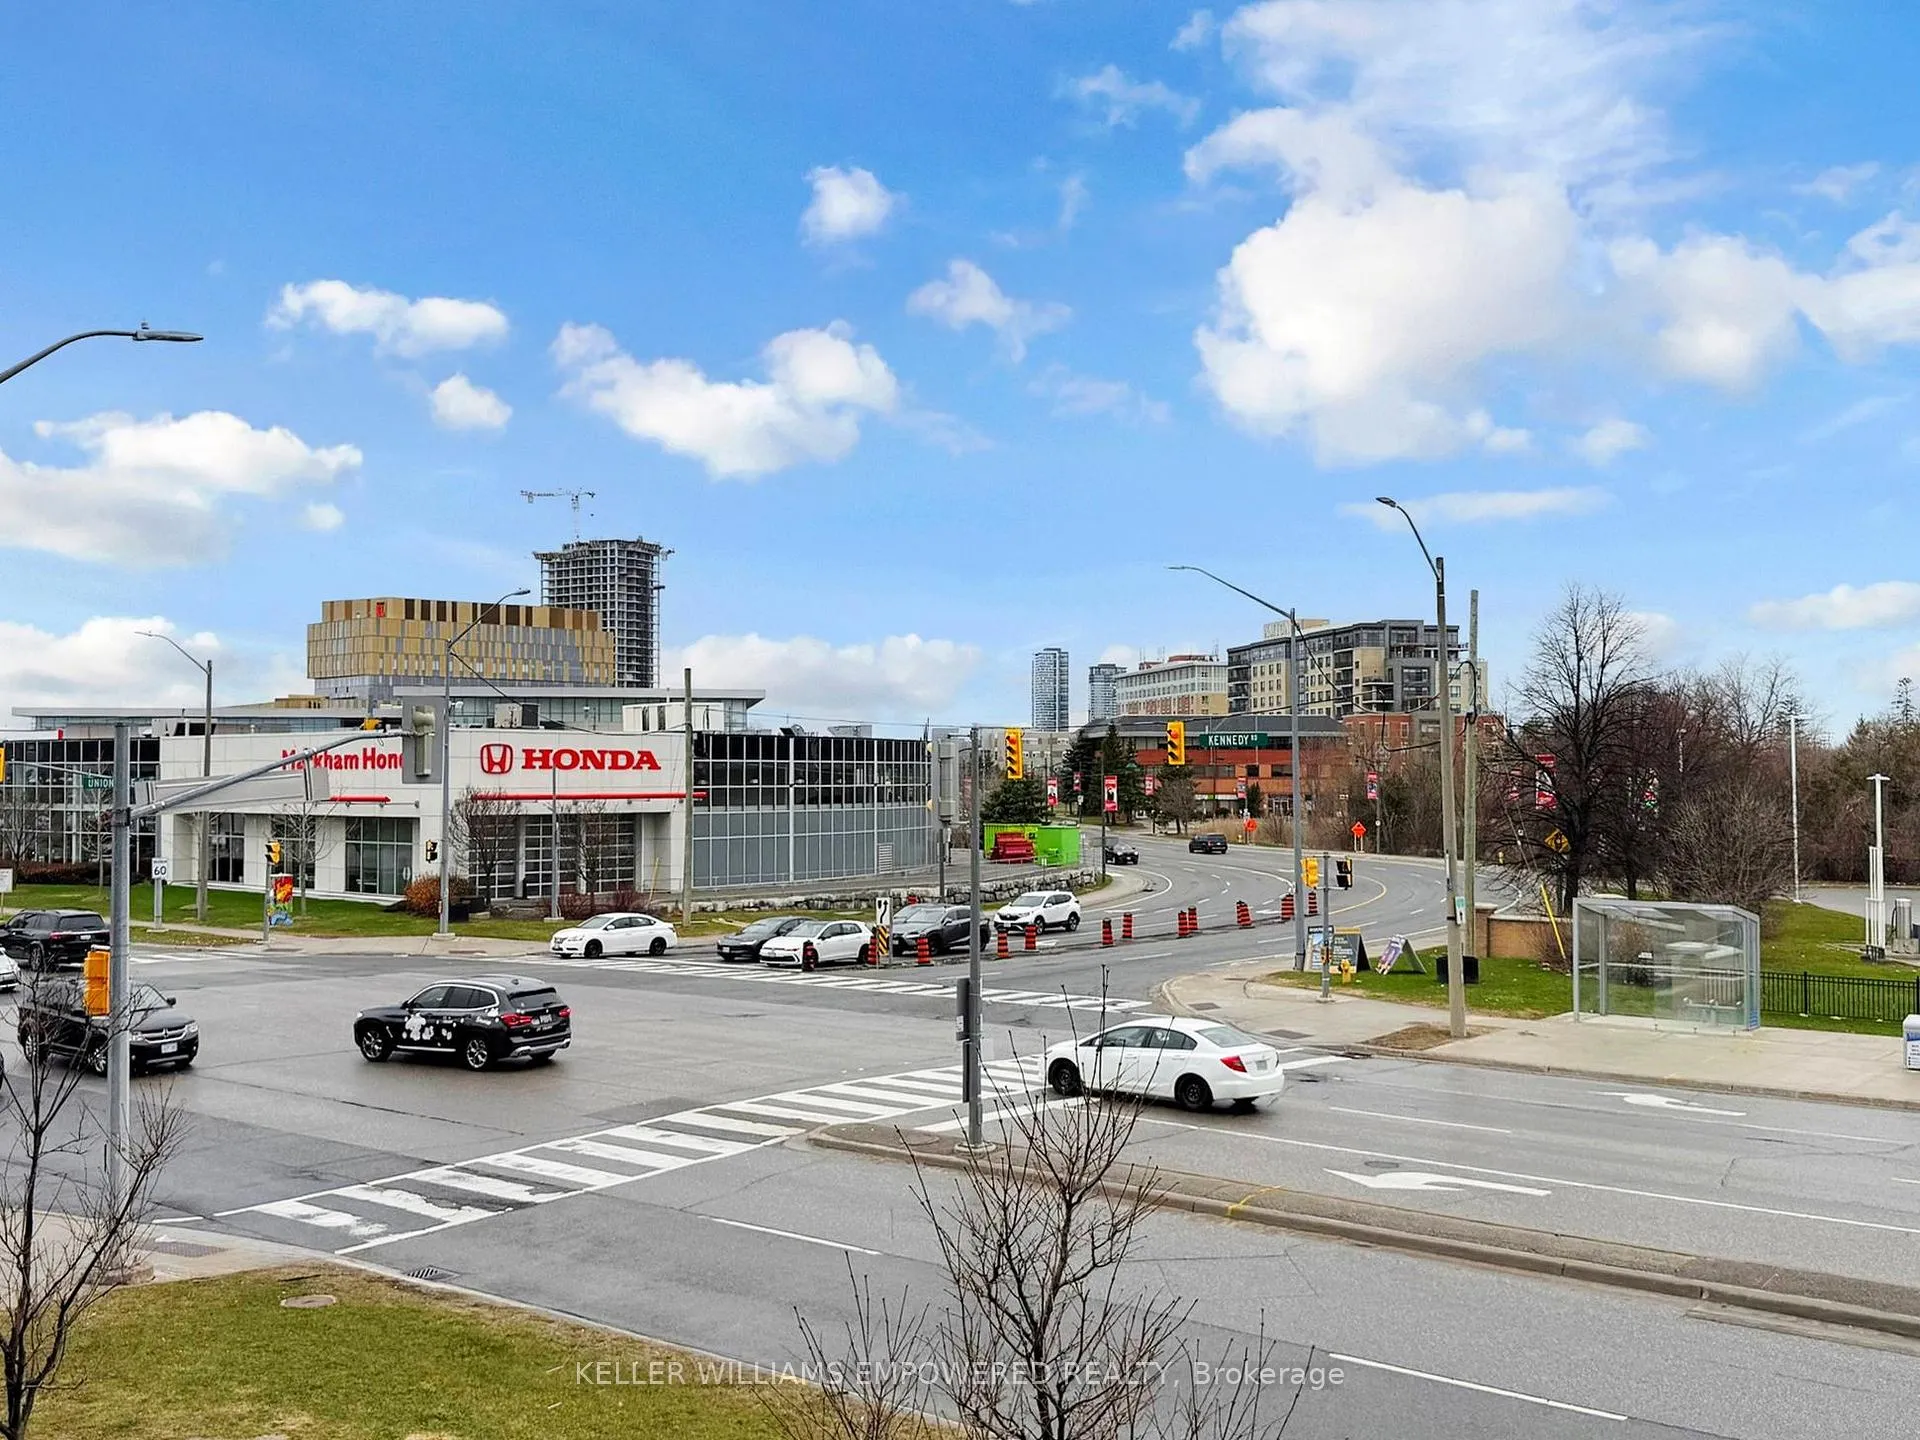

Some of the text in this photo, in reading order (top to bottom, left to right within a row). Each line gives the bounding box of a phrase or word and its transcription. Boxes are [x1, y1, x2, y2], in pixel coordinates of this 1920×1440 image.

[1208, 734, 1249, 746] KENNEDY
[521, 748, 662, 770] HONDA
[88, 778, 114, 788] UNION
[154, 865, 167, 876] 60
